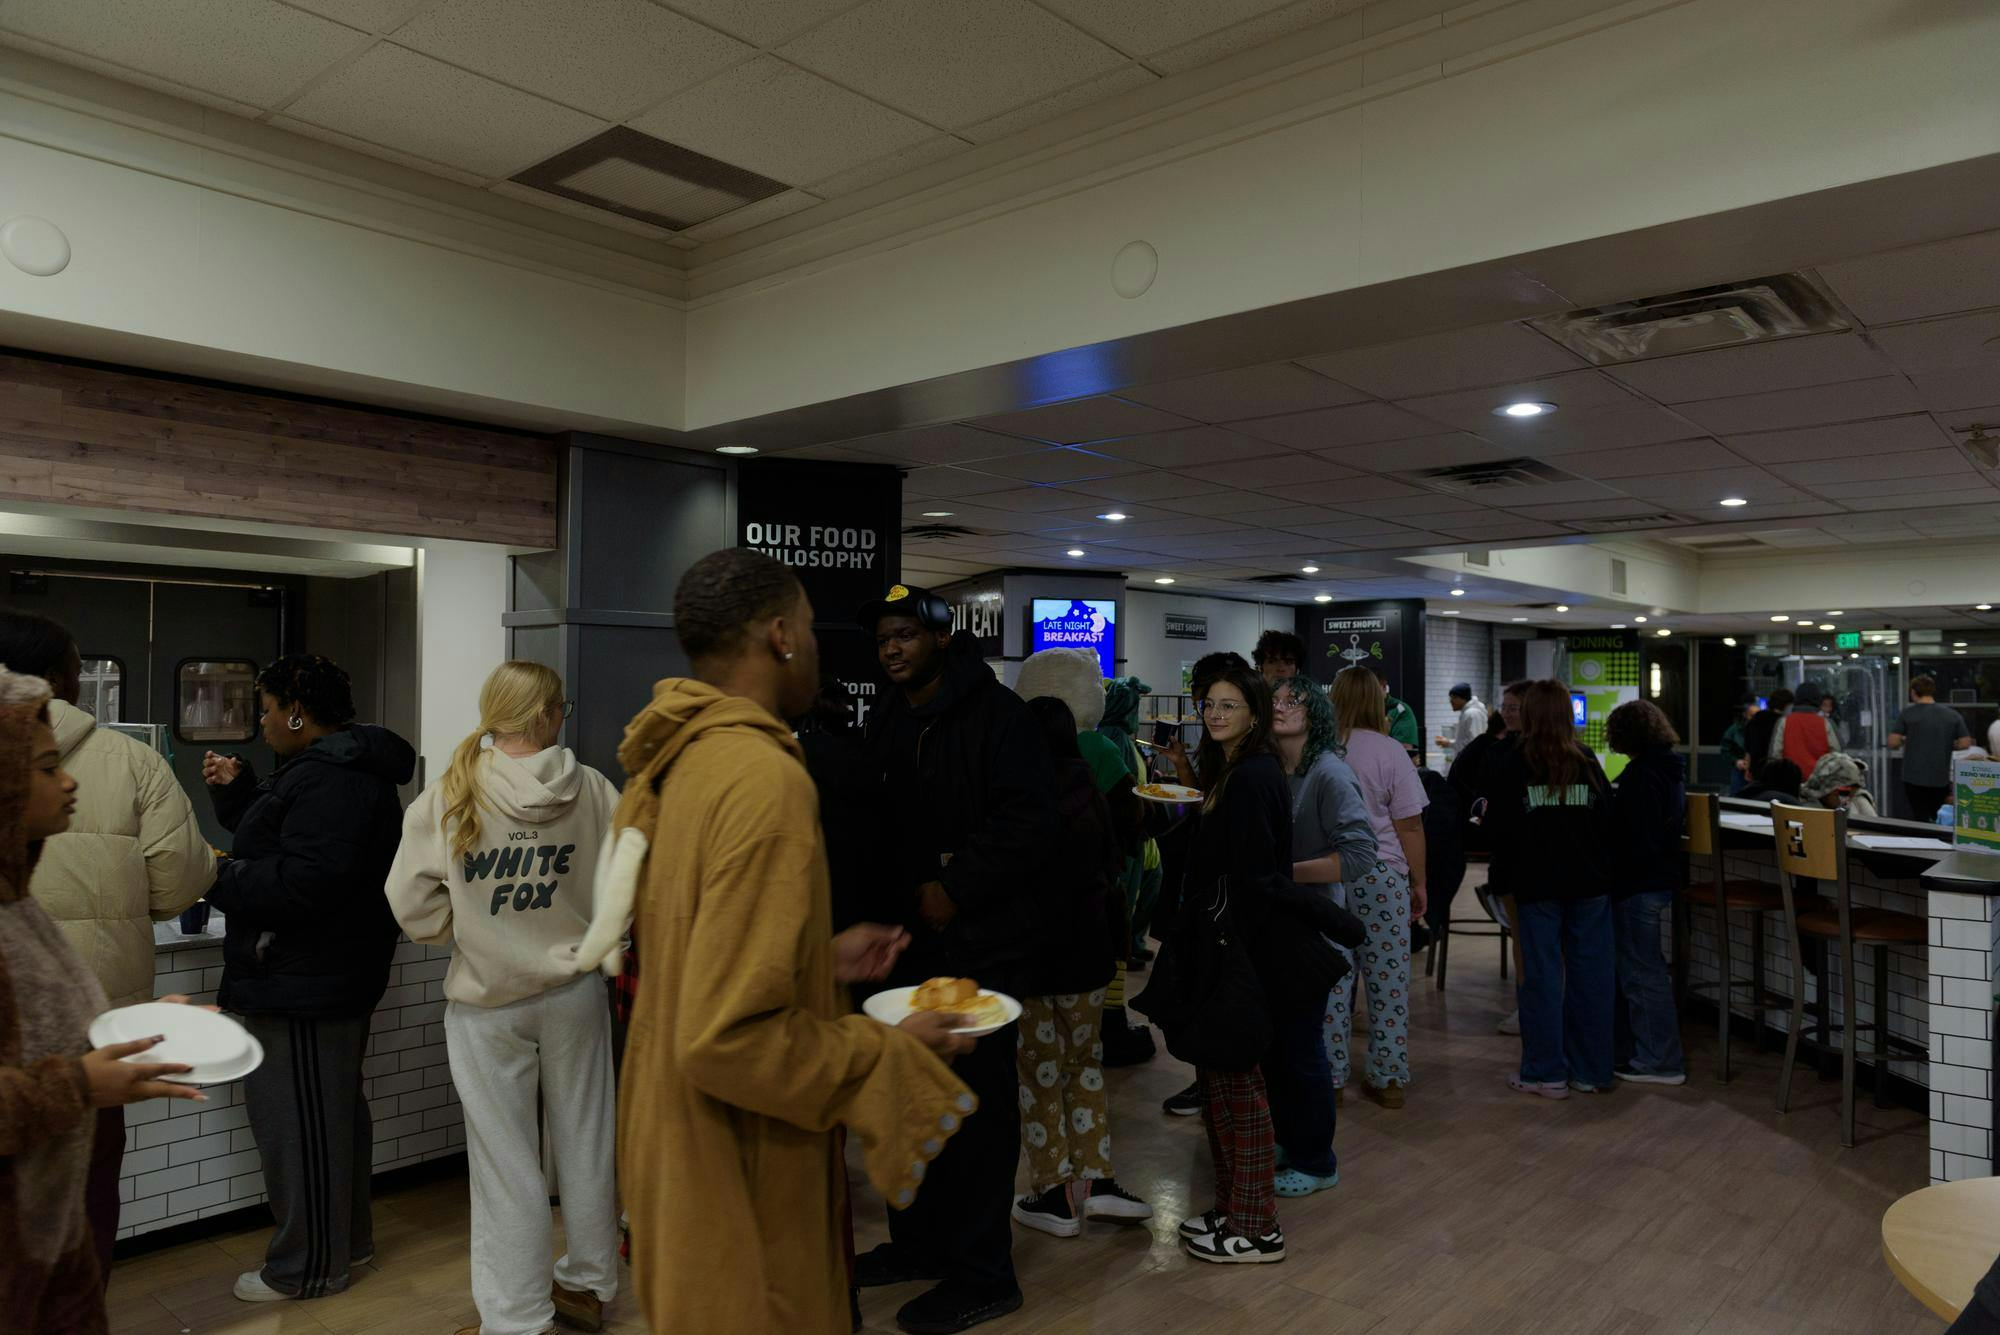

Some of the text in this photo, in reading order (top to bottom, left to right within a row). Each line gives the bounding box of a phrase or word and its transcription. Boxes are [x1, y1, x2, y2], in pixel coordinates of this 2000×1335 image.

[746, 522, 877, 550] OUR FOOD
[747, 547, 876, 569] ILOSOPHY
[972, 600, 1000, 637] EAT
[1043, 621, 1091, 631] LATE NIGHT
[1328, 620, 1381, 629] SWEET SHOPPE
[1167, 623, 1184, 631] SWEET
[1043, 632, 1104, 643] BREAKFAST
[1839, 633, 1859, 648] EXIT
[837, 678, 876, 695] om
[508, 831, 538, 841] VOL.3
[464, 844, 576, 883] WHITE
[490, 880, 558, 916] FOX
